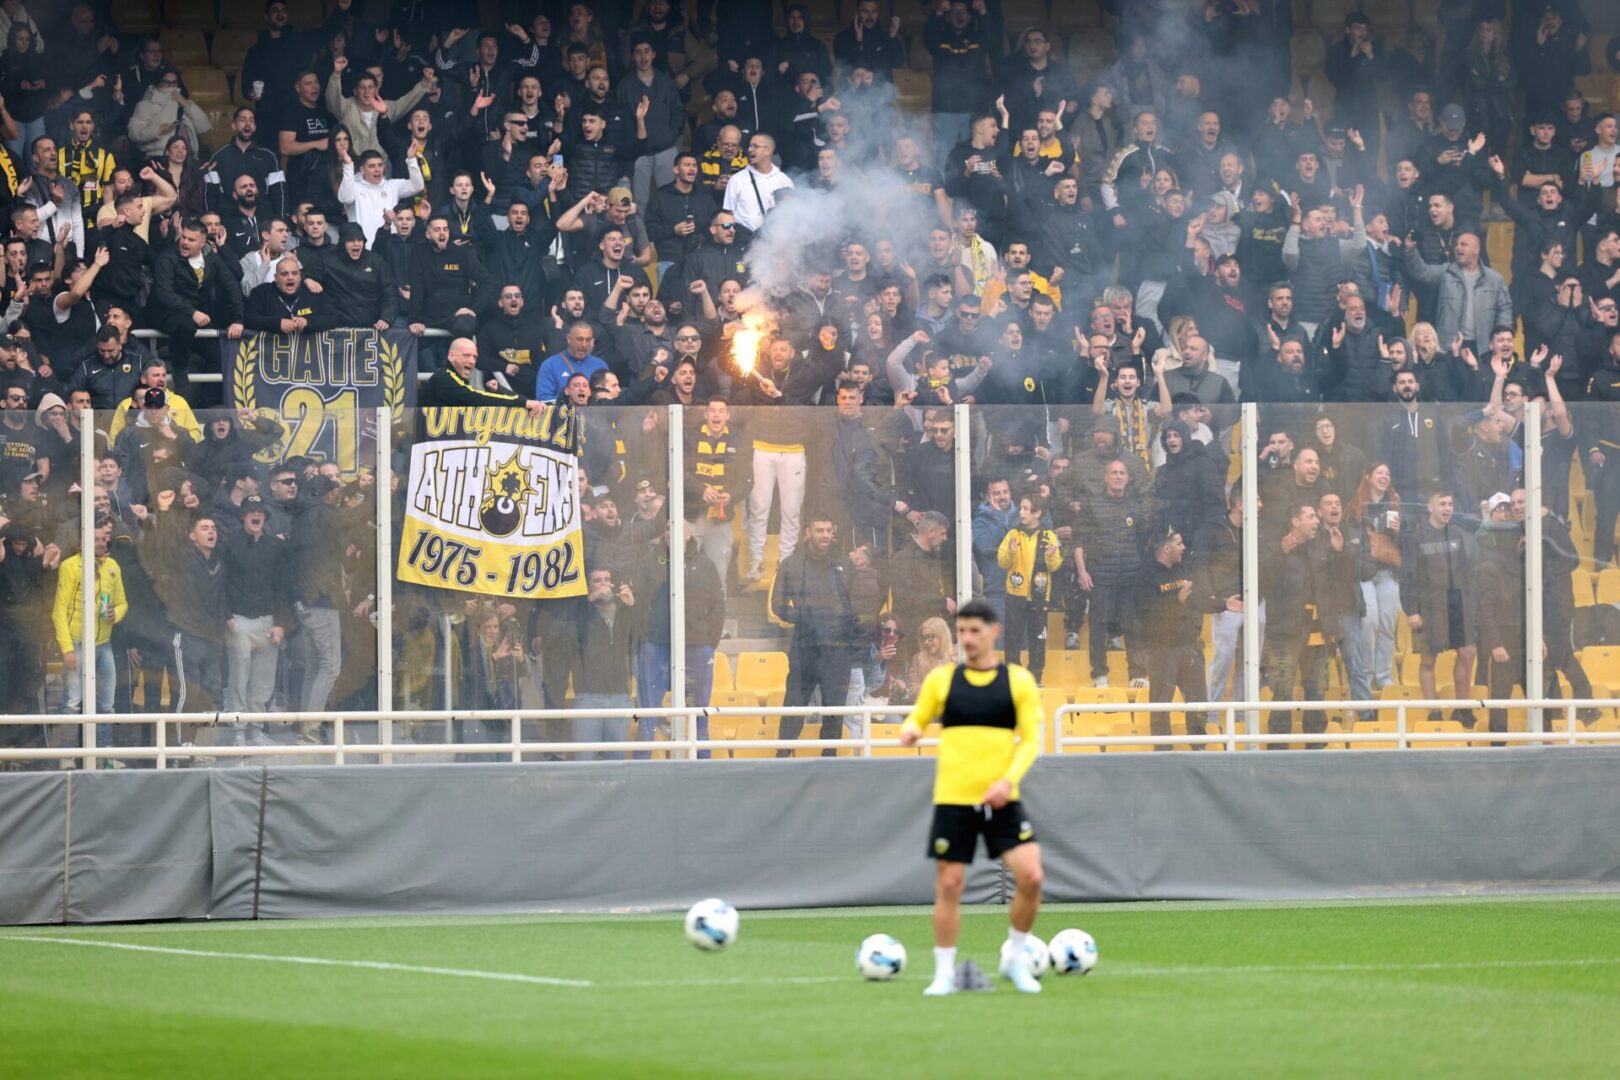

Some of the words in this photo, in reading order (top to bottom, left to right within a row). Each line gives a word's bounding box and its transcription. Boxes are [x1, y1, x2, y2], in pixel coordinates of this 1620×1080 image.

[297, 307, 313, 316] AEK
[259, 328, 379, 386] GATE
[280, 384, 360, 477] 21
[407, 528, 482, 587] 1975
[505, 540, 579, 594] 1982
